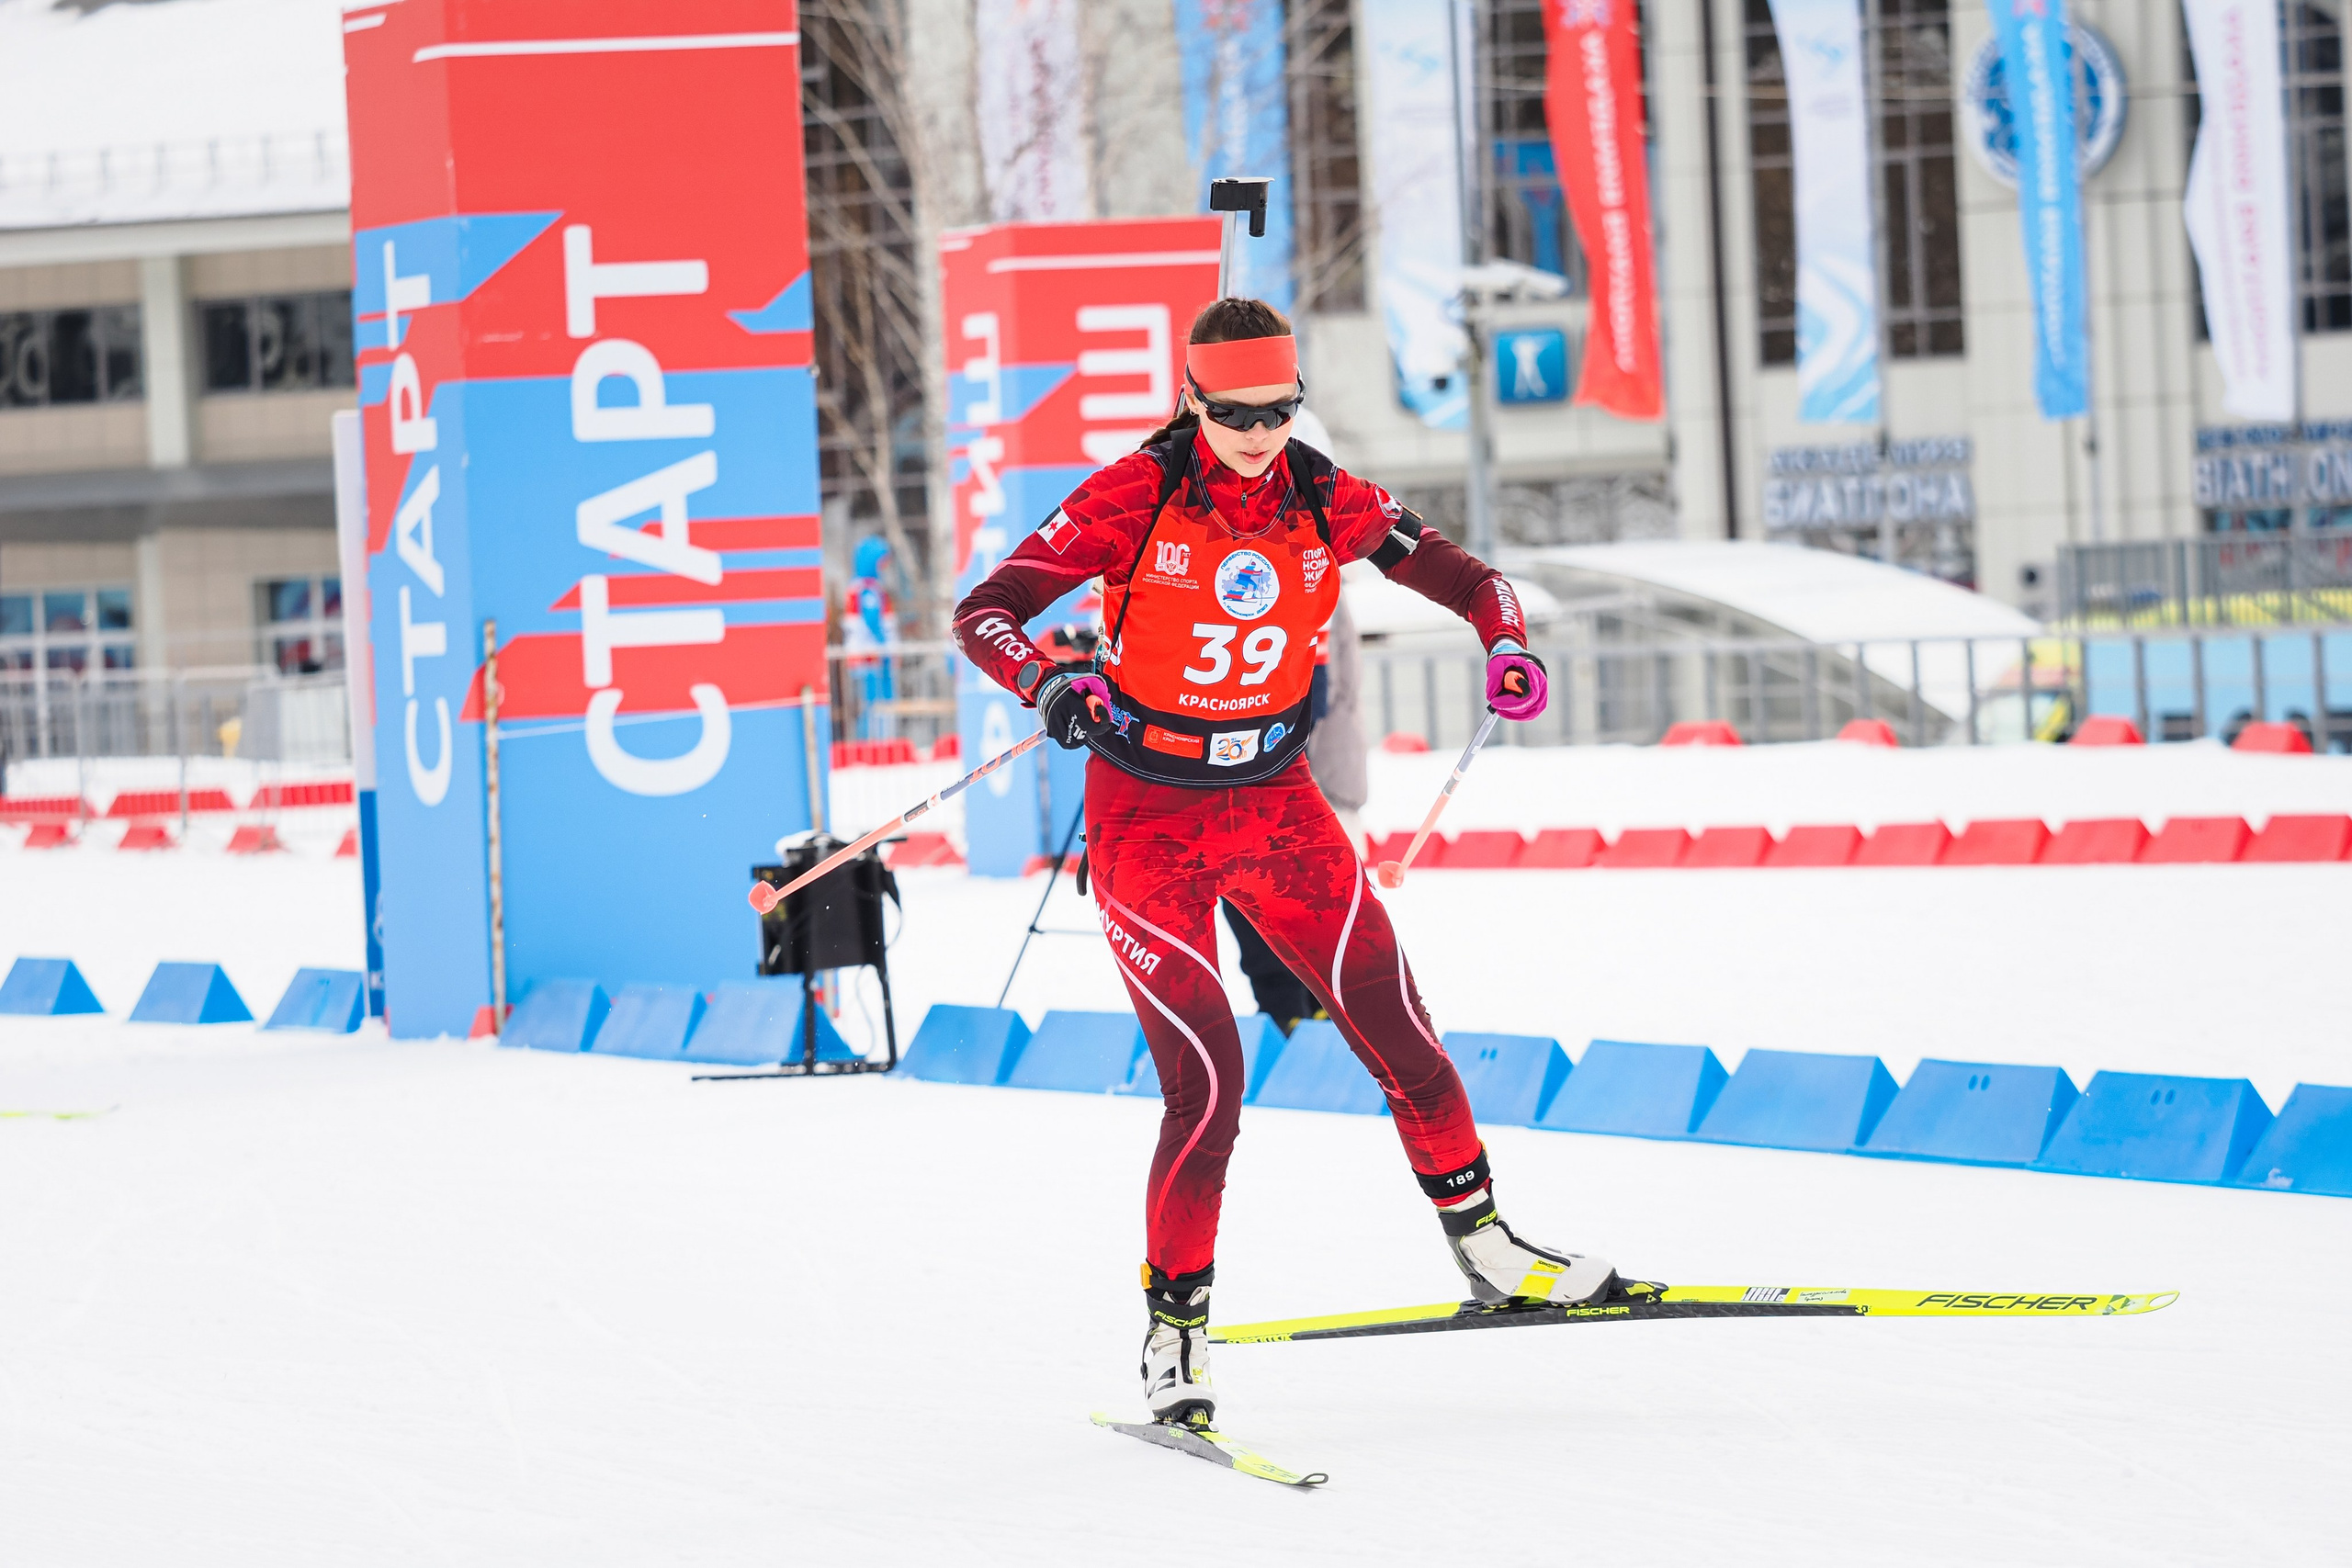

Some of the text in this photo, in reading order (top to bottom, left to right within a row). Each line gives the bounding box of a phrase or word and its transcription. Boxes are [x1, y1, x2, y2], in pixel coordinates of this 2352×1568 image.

[563, 223, 732, 797] СТАРТ
[382, 240, 453, 807] СТАРТ
[962, 310, 1014, 798] ФНИШ
[1220, 551, 1272, 571] ПЕРВЕНСТВО РОССИИ
[1303, 546, 1326, 560] СПОРТ
[1142, 577, 1200, 590] РОССИЙСКОЙ ФЕДЕРАЦИИ
[1145, 572, 1179, 583] МИНИСТЕРСТВО
[993, 632, 1035, 662] ПСБ
[1182, 622, 1288, 687] 39
[1178, 693, 1272, 712] КРАСНОЯРСК
[1163, 732, 1200, 744] КРАСНОЯРСКИЙ
[907, 807, 927, 822] PILOT
[1446, 1170, 1476, 1188] 189
[1916, 1293, 2098, 1311] FISCHER
[1154, 1310, 1207, 1327] FISCHER
[1566, 1306, 1631, 1317] FISCHER
[1168, 1427, 1184, 1439] FISCHER
